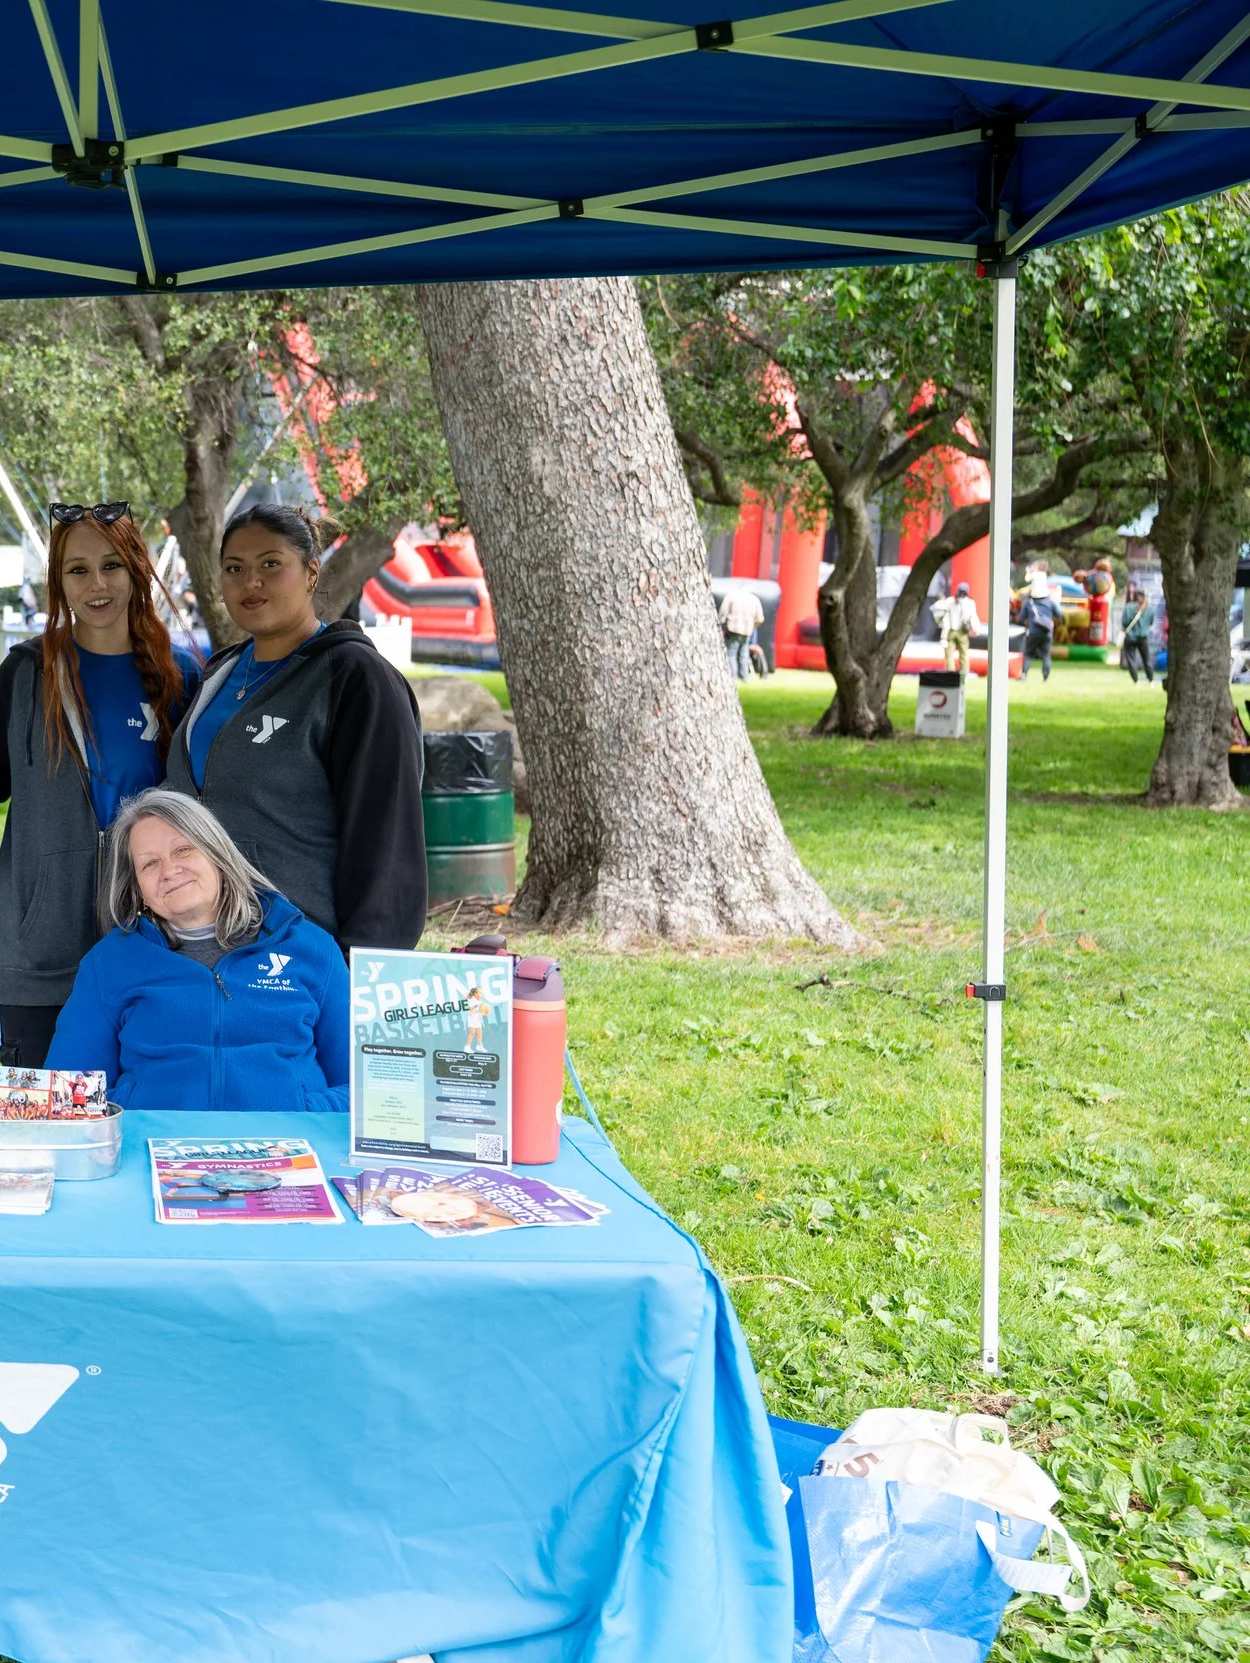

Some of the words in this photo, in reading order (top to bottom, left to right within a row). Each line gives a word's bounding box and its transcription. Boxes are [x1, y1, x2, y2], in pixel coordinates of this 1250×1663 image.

[127, 717, 142, 728] the
[245, 724, 258, 733] the
[257, 963, 269, 971] the
[256, 977, 280, 985] YMCA
[354, 966, 508, 1022] SPRING
[384, 1006, 419, 1023] GIRLS
[421, 999, 471, 1018] LEAGUE
[354, 1004, 507, 1045] BASKETBLL
[152, 1140, 306, 1158] SPRING
[197, 1161, 283, 1170] GYMNASTICS
[483, 1189, 544, 1223] EVENTS
[502, 1184, 562, 1222] SENIOR
